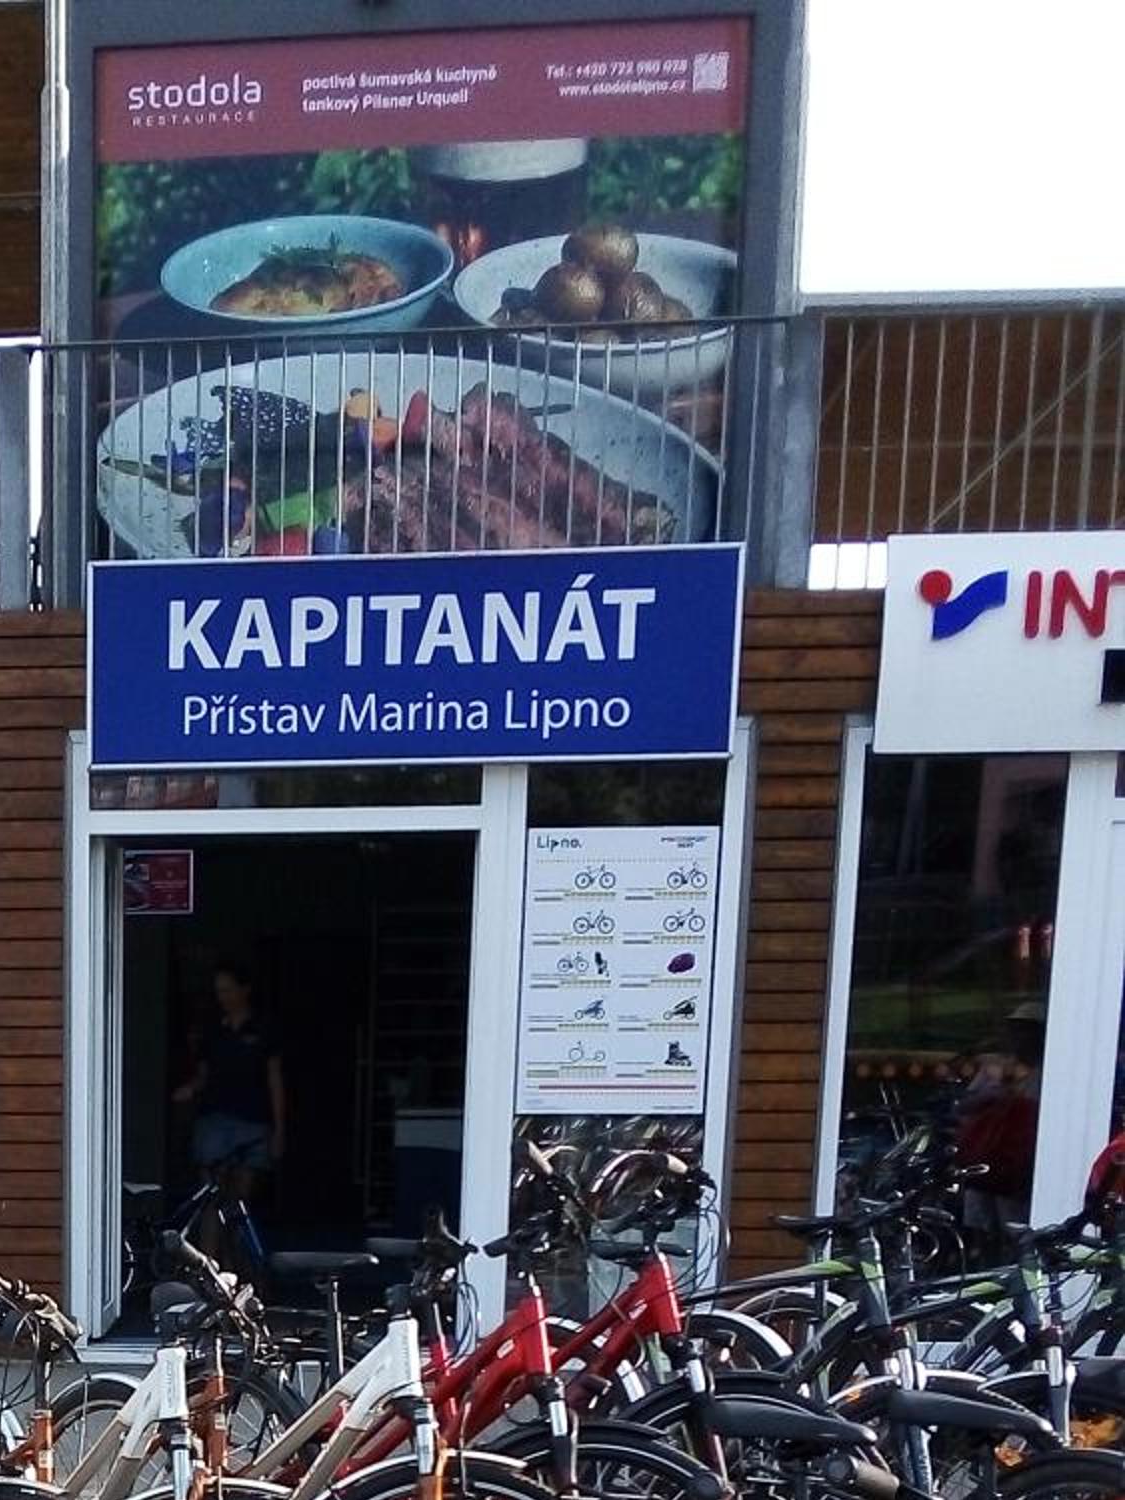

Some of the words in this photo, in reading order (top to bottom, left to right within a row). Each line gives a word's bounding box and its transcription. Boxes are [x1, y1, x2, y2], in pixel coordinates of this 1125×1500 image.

[128, 72, 262, 111] stodola
[302, 73, 355, 93] poctivá
[359, 67, 432, 89] šumavská
[435, 63, 498, 85] kuchyně
[302, 94, 359, 114] tankový
[362, 93, 414, 110] Pilsner
[417, 89, 469, 109] Urquell
[131, 110, 257, 128] RESTAURACE
[168, 574, 656, 671] KAPITANÁT
[183, 695, 325, 737] Přístav
[338, 691, 489, 733] Marina
[504, 688, 633, 740] Lipno
